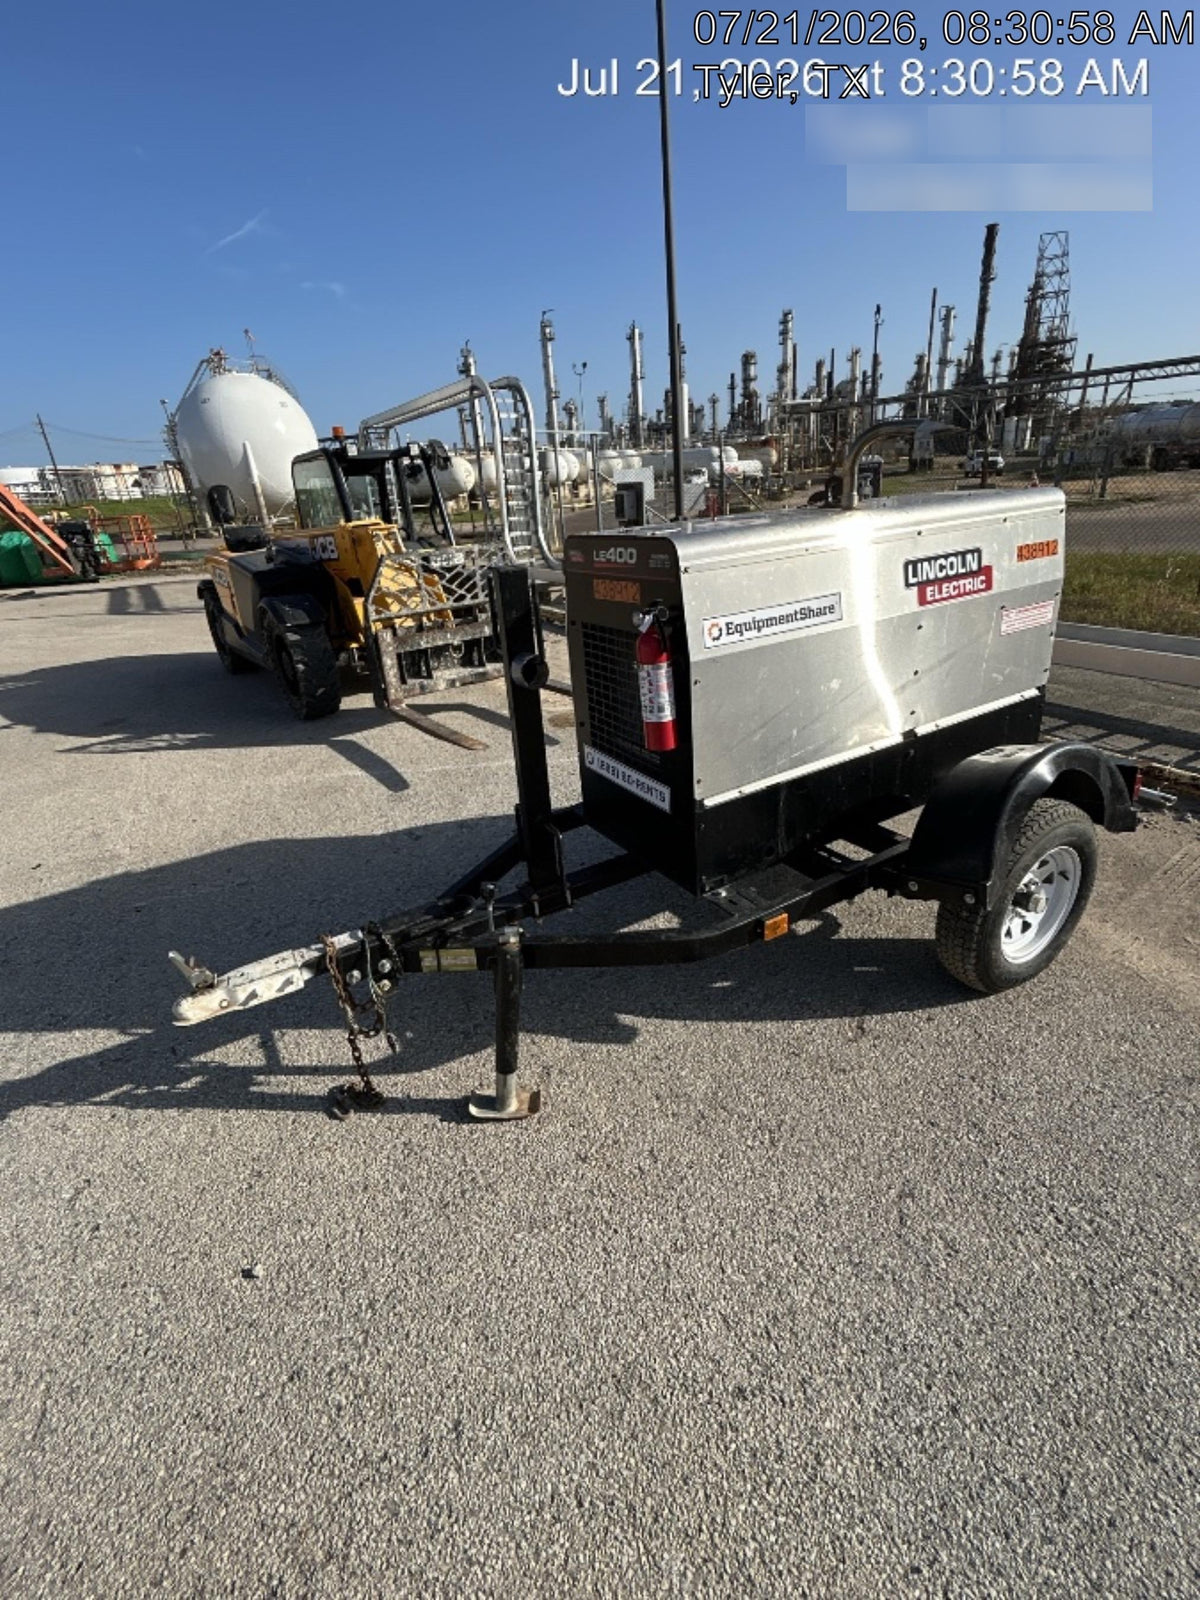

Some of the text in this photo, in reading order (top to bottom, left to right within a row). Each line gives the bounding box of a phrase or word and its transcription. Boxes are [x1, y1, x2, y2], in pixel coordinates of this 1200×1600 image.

[312, 536, 339, 560] JCB
[593, 547, 638, 565] LE400
[1016, 539, 1058, 562] 438912
[907, 552, 979, 584] LINCOLN
[925, 575, 986, 602] ELECTRIC
[724, 603, 836, 637] EquipmentShare
